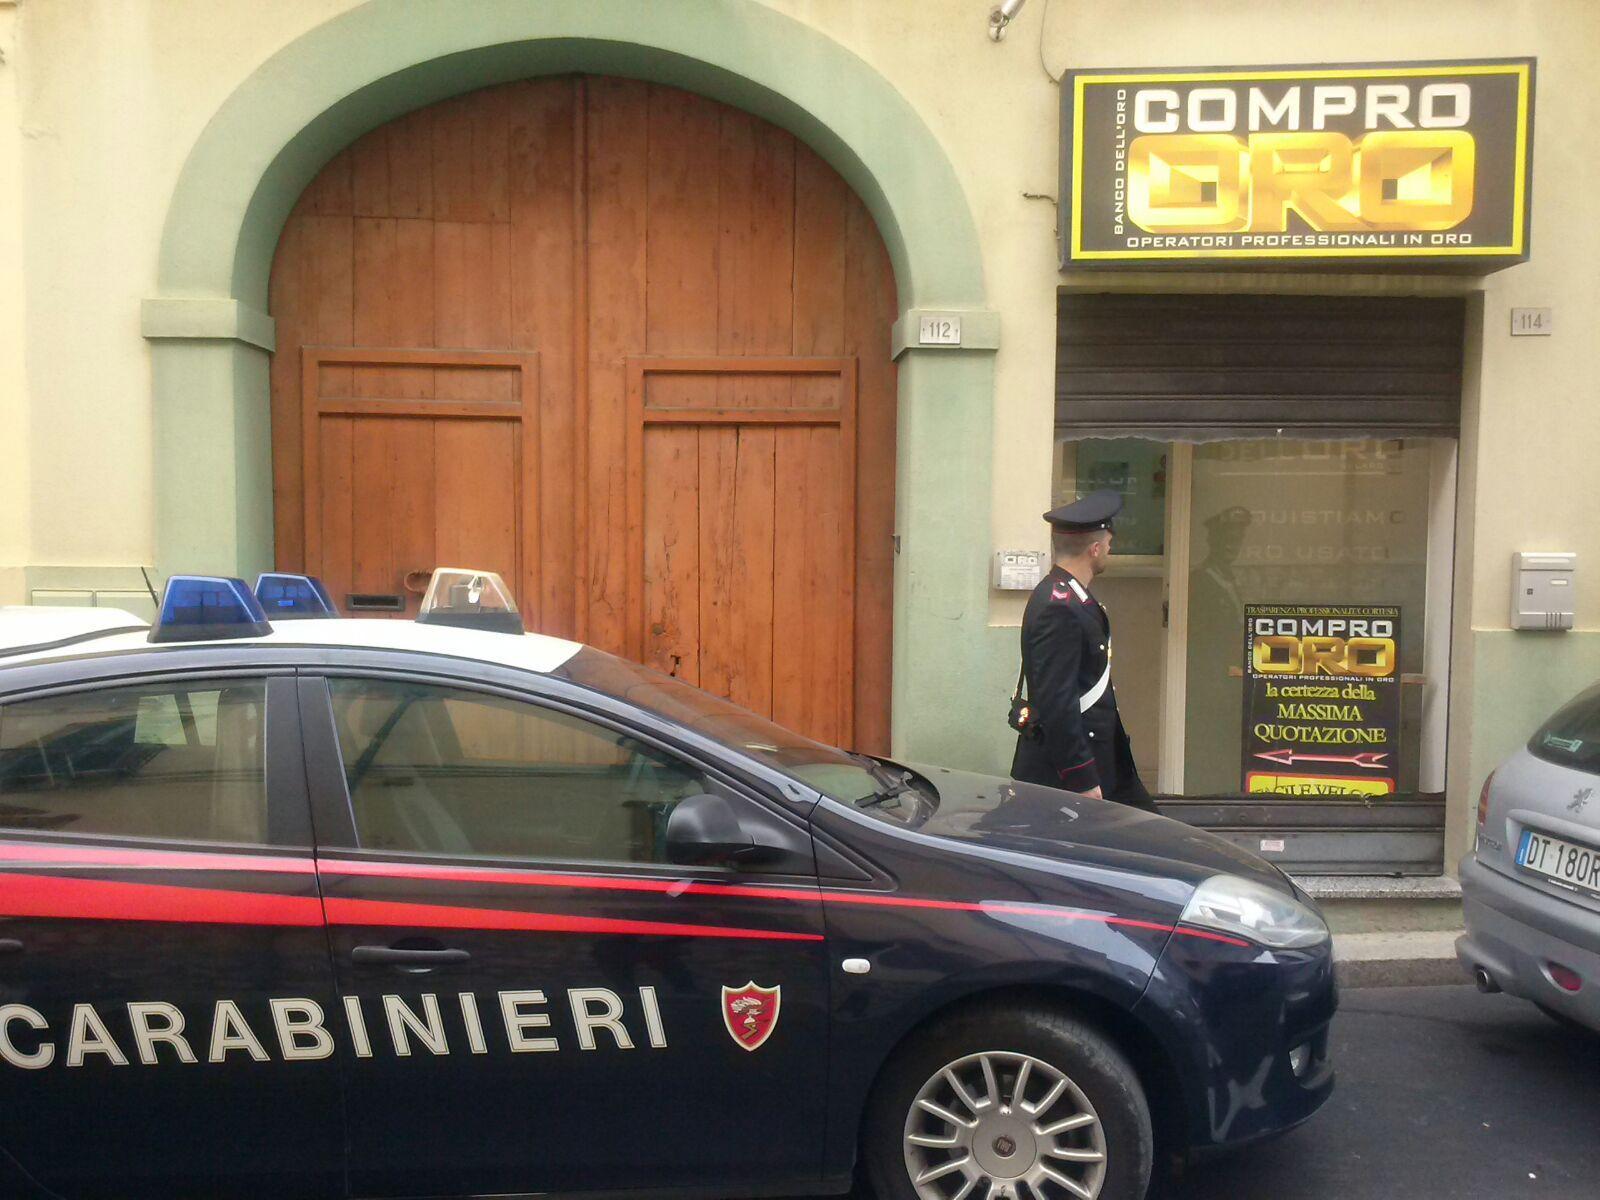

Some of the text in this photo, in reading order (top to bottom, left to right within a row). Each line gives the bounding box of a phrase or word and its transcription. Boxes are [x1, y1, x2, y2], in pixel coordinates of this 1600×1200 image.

[1134, 83, 1471, 133] COMPRO
[1114, 89, 1127, 235] BANCO DELL'ORO
[1127, 131, 1476, 233] ORO
[1127, 233, 1473, 248] OPERATORI PROFESSIONALI IN ORO
[929, 321, 951, 338] 112
[1521, 313, 1543, 329] 114
[1255, 618, 1393, 638] COMPRO
[1252, 636, 1396, 677] ORO
[1298, 674, 1363, 682] PROFESSIONALI
[1265, 682, 1377, 701] la certezza della
[1276, 703, 1364, 722] MASSIMA
[1254, 723, 1388, 744] QUOTAZIONE
[1526, 835, 1551, 869] DT
[0, 985, 668, 1070] CARABINIERI
